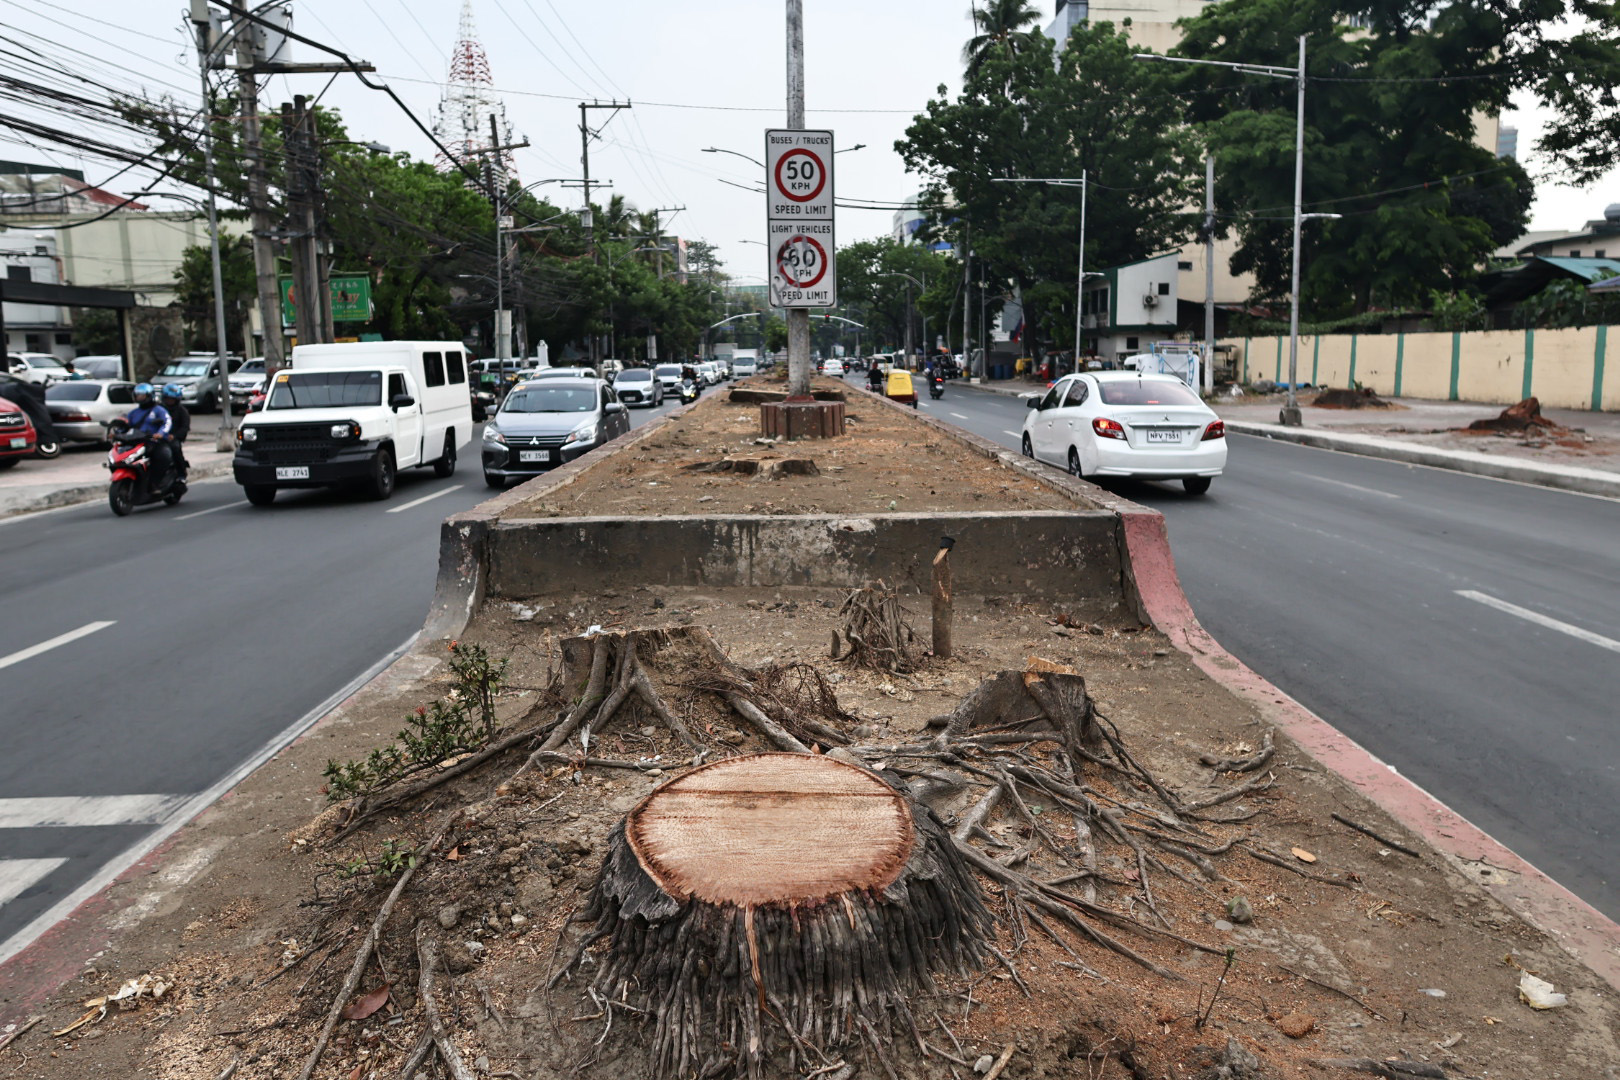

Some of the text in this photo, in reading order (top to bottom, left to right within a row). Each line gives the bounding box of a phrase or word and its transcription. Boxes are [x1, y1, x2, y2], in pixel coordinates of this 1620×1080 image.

[796, 136, 800, 145] /
[787, 161, 814, 180] 50
[776, 205, 826, 214] SPEED LIMIT
[797, 226, 830, 234] VEHICLES
[788, 248, 816, 267] 60
[780, 291, 828, 300] PEED LIMIT
